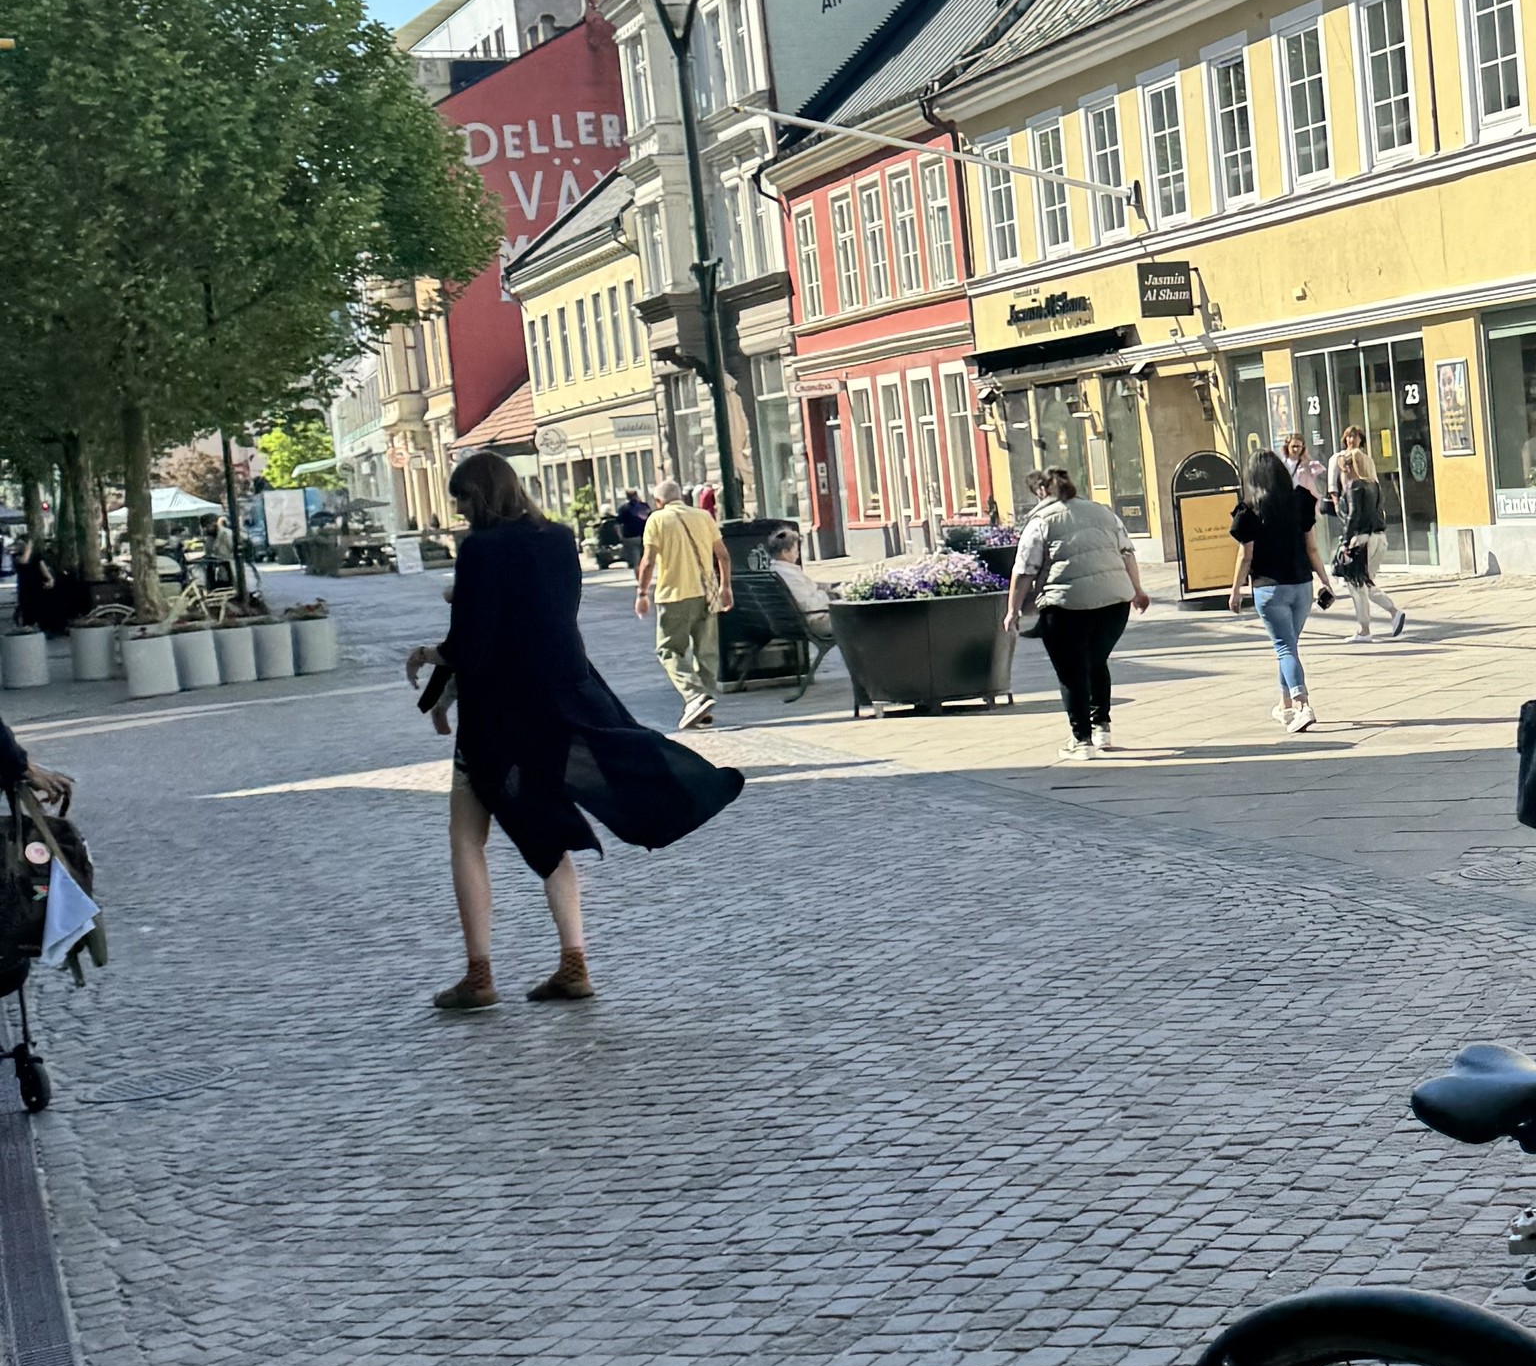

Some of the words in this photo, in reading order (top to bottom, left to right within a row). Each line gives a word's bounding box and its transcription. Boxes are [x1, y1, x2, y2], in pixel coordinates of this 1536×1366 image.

[508, 157, 606, 221] VÄ
[1144, 272, 1185, 286] Jasmin
[1143, 288, 1157, 302] Al
[1158, 288, 1190, 301] Sham
[1405, 383, 1420, 404] 23
[1307, 395, 1320, 415] 23
